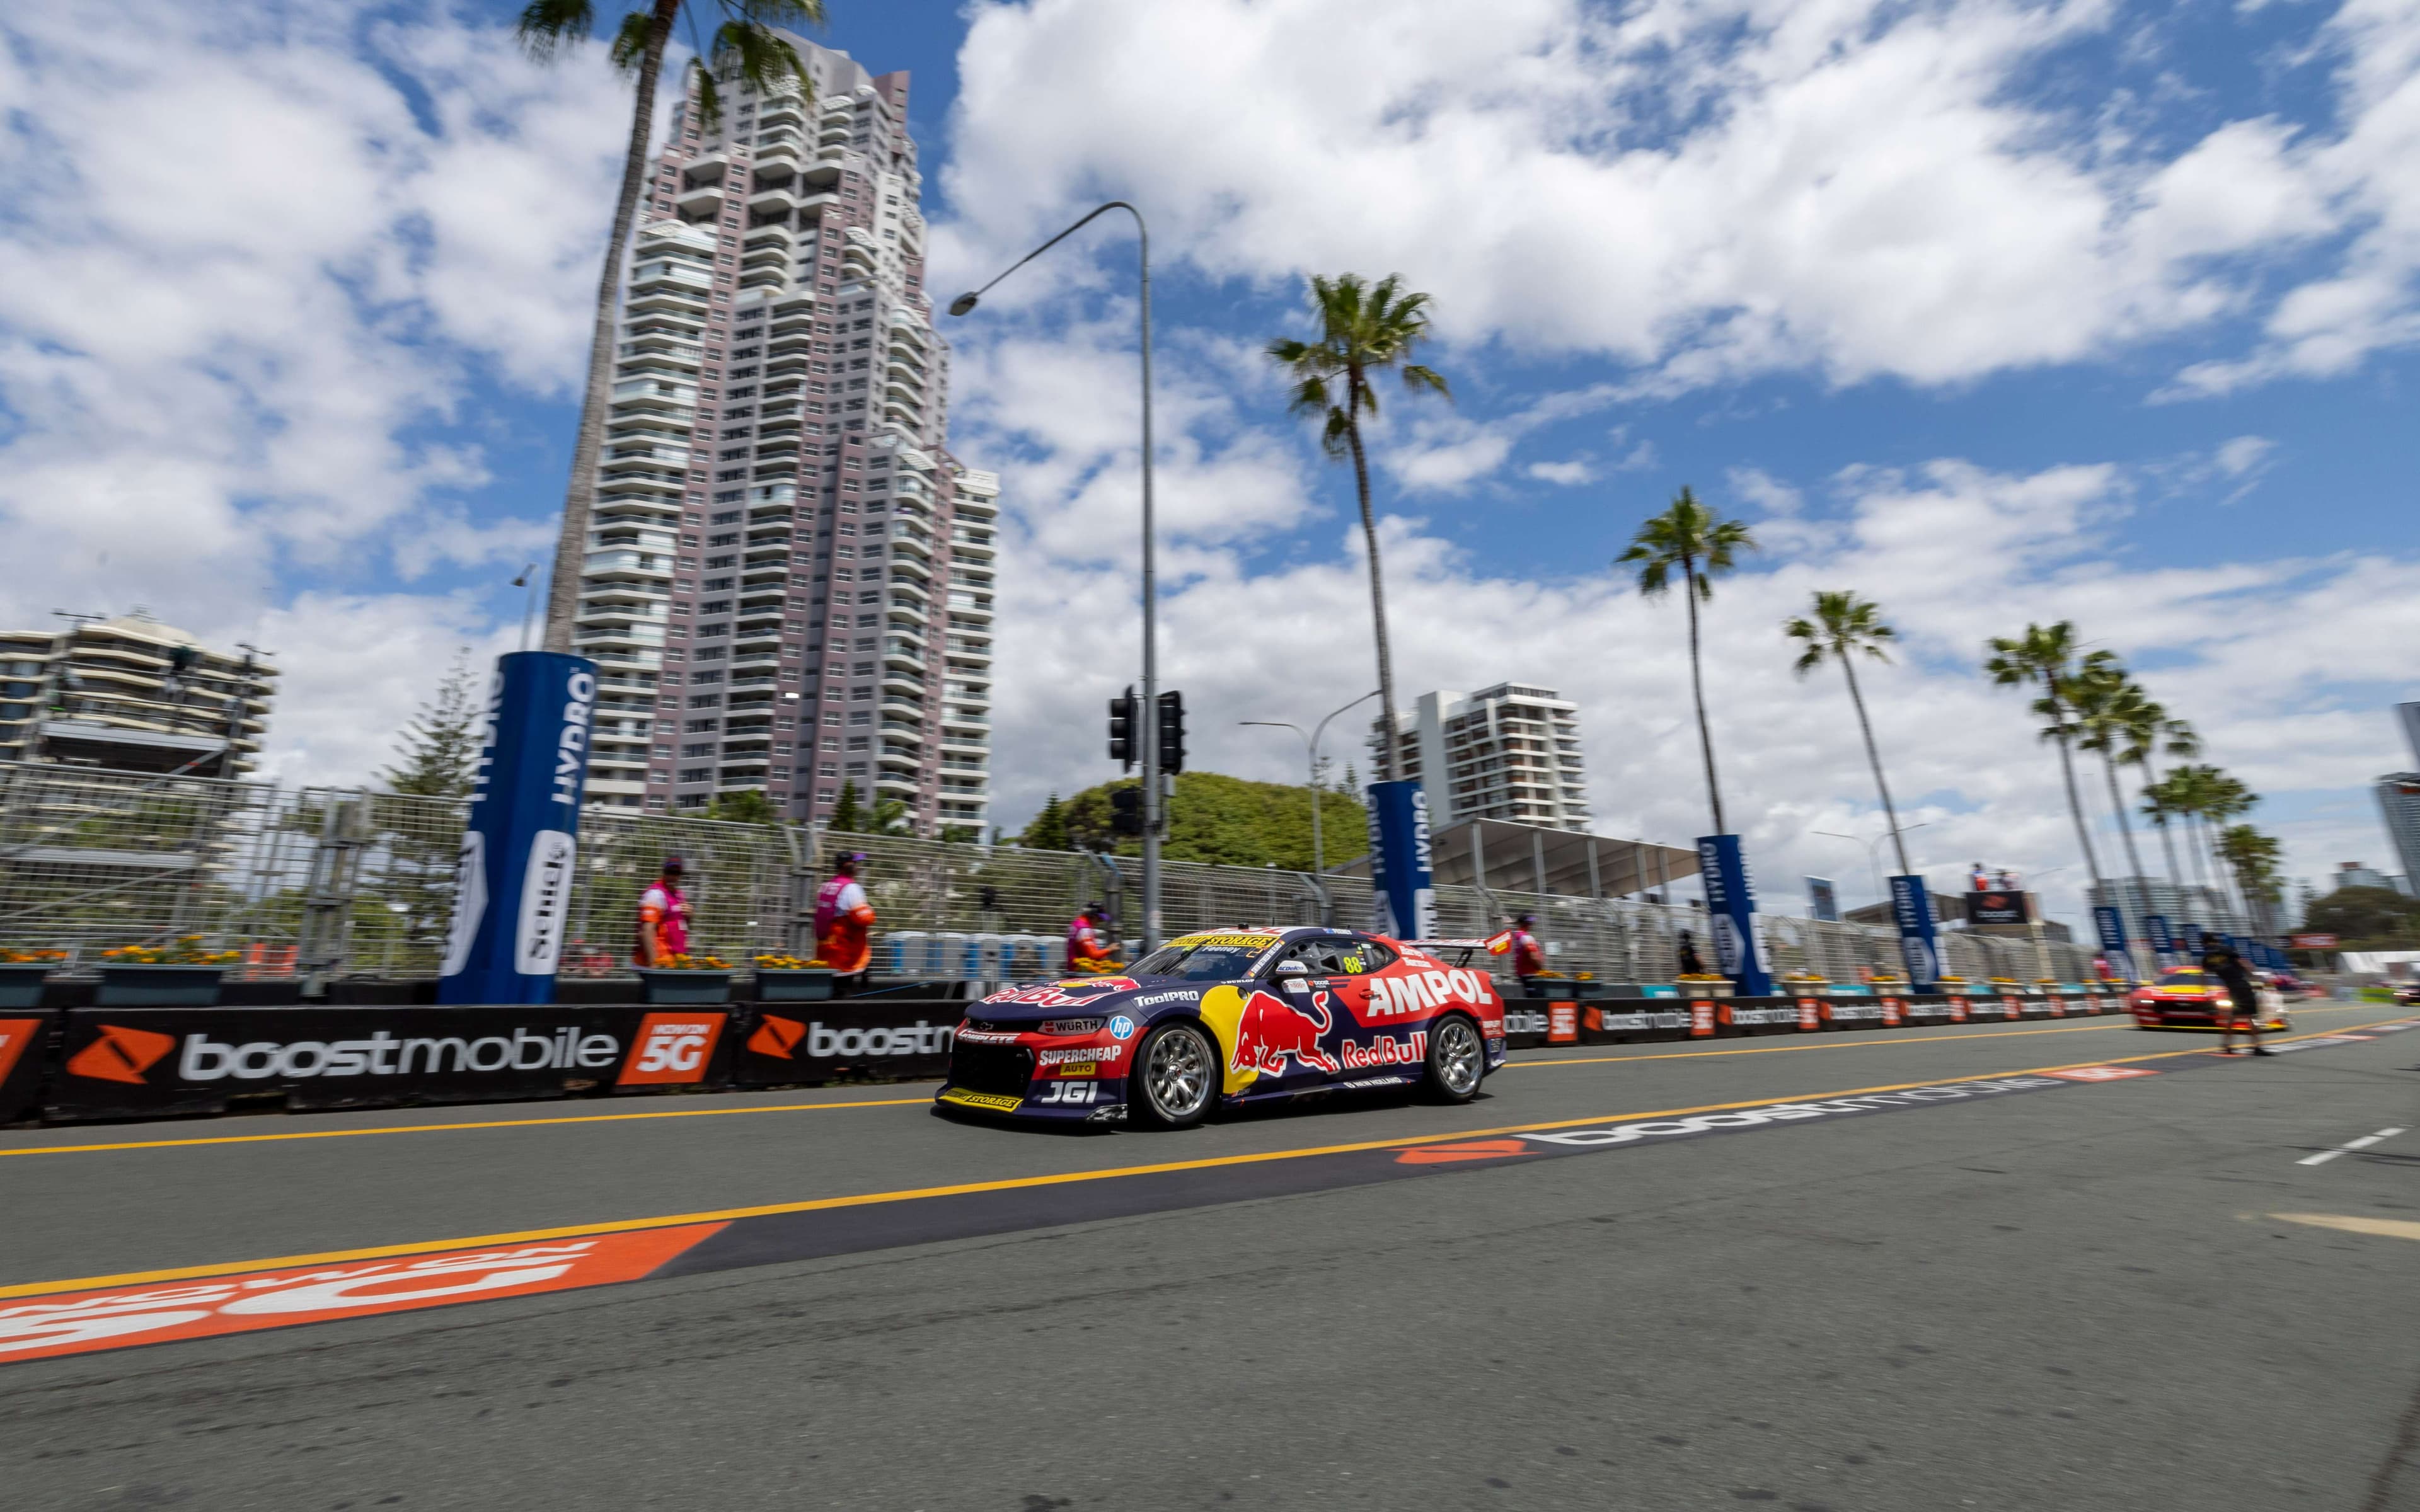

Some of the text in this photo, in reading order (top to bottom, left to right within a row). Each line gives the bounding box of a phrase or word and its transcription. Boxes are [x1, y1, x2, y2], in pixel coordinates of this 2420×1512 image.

[551, 672, 596, 805] HYDRO
[1209, 936, 1273, 946] STORAGE
[1343, 956, 1362, 973] 88
[1134, 990, 1199, 1007] ToolPRO
[1366, 969, 1493, 1017] AMPOL
[1056, 1020, 1098, 1032] WÜRTH
[1115, 1018, 1130, 1039] hp
[635, 1035, 708, 1072] 5G
[1039, 1045, 1122, 1066] SUPERCHEAP
[1354, 1076, 1402, 1088] NEW HOLLAND
[969, 1095, 1017, 1107] STORAGE
[1040, 1080, 1100, 1104] JGI
